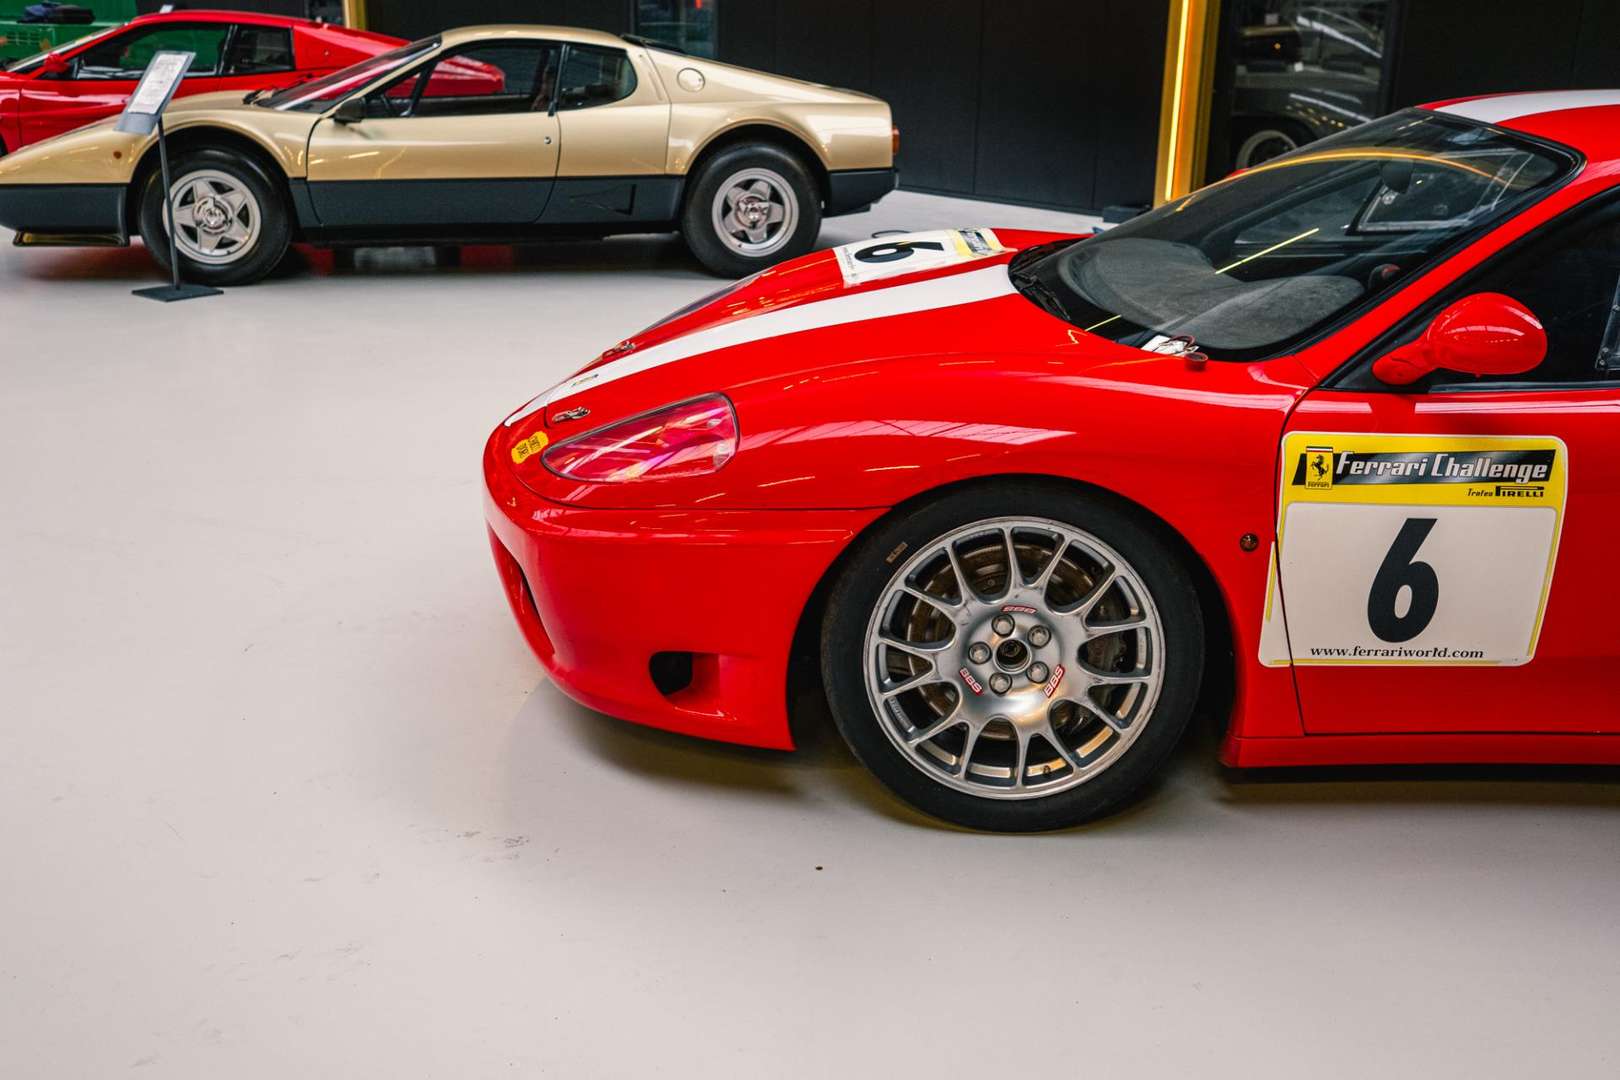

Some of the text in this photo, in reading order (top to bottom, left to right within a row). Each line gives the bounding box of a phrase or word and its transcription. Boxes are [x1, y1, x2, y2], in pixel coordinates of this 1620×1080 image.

[854, 241, 945, 264] 6
[1336, 451, 1548, 484] Ferrari Challenge
[1495, 485, 1545, 498] PIRELLI
[1367, 518, 1439, 643] 6
[1310, 646, 1484, 659] www.ferrariworld.com
[960, 667, 983, 694] BBS
[1043, 665, 1064, 697] BBS
